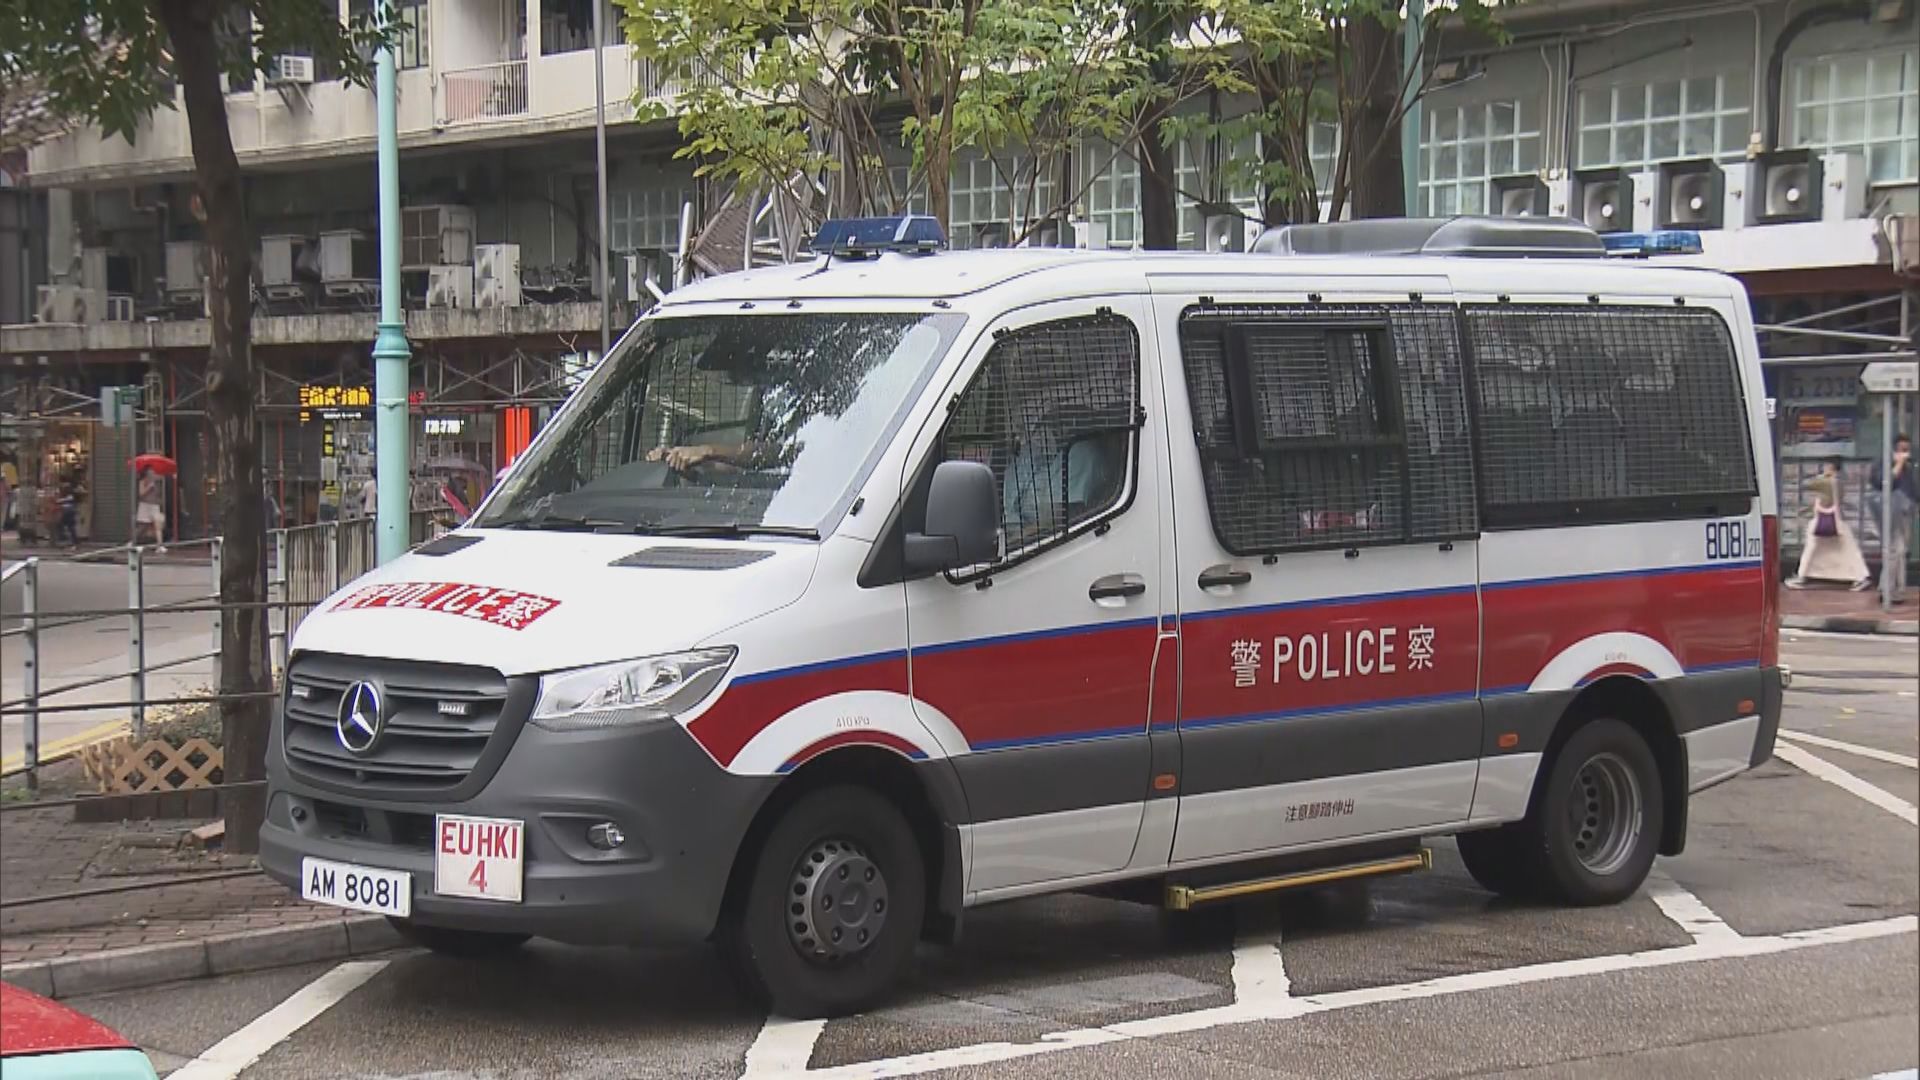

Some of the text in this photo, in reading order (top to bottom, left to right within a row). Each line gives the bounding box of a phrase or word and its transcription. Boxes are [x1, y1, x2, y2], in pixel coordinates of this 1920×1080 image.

[1706, 520, 1747, 559] 8081
[360, 583, 518, 619] POLICE
[489, 595, 552, 628] 察
[1230, 624, 1436, 687] 警 POLICE 察
[441, 821, 518, 859] EUHKI
[309, 868, 398, 910] AM 8081
[468, 860, 489, 893] 4
